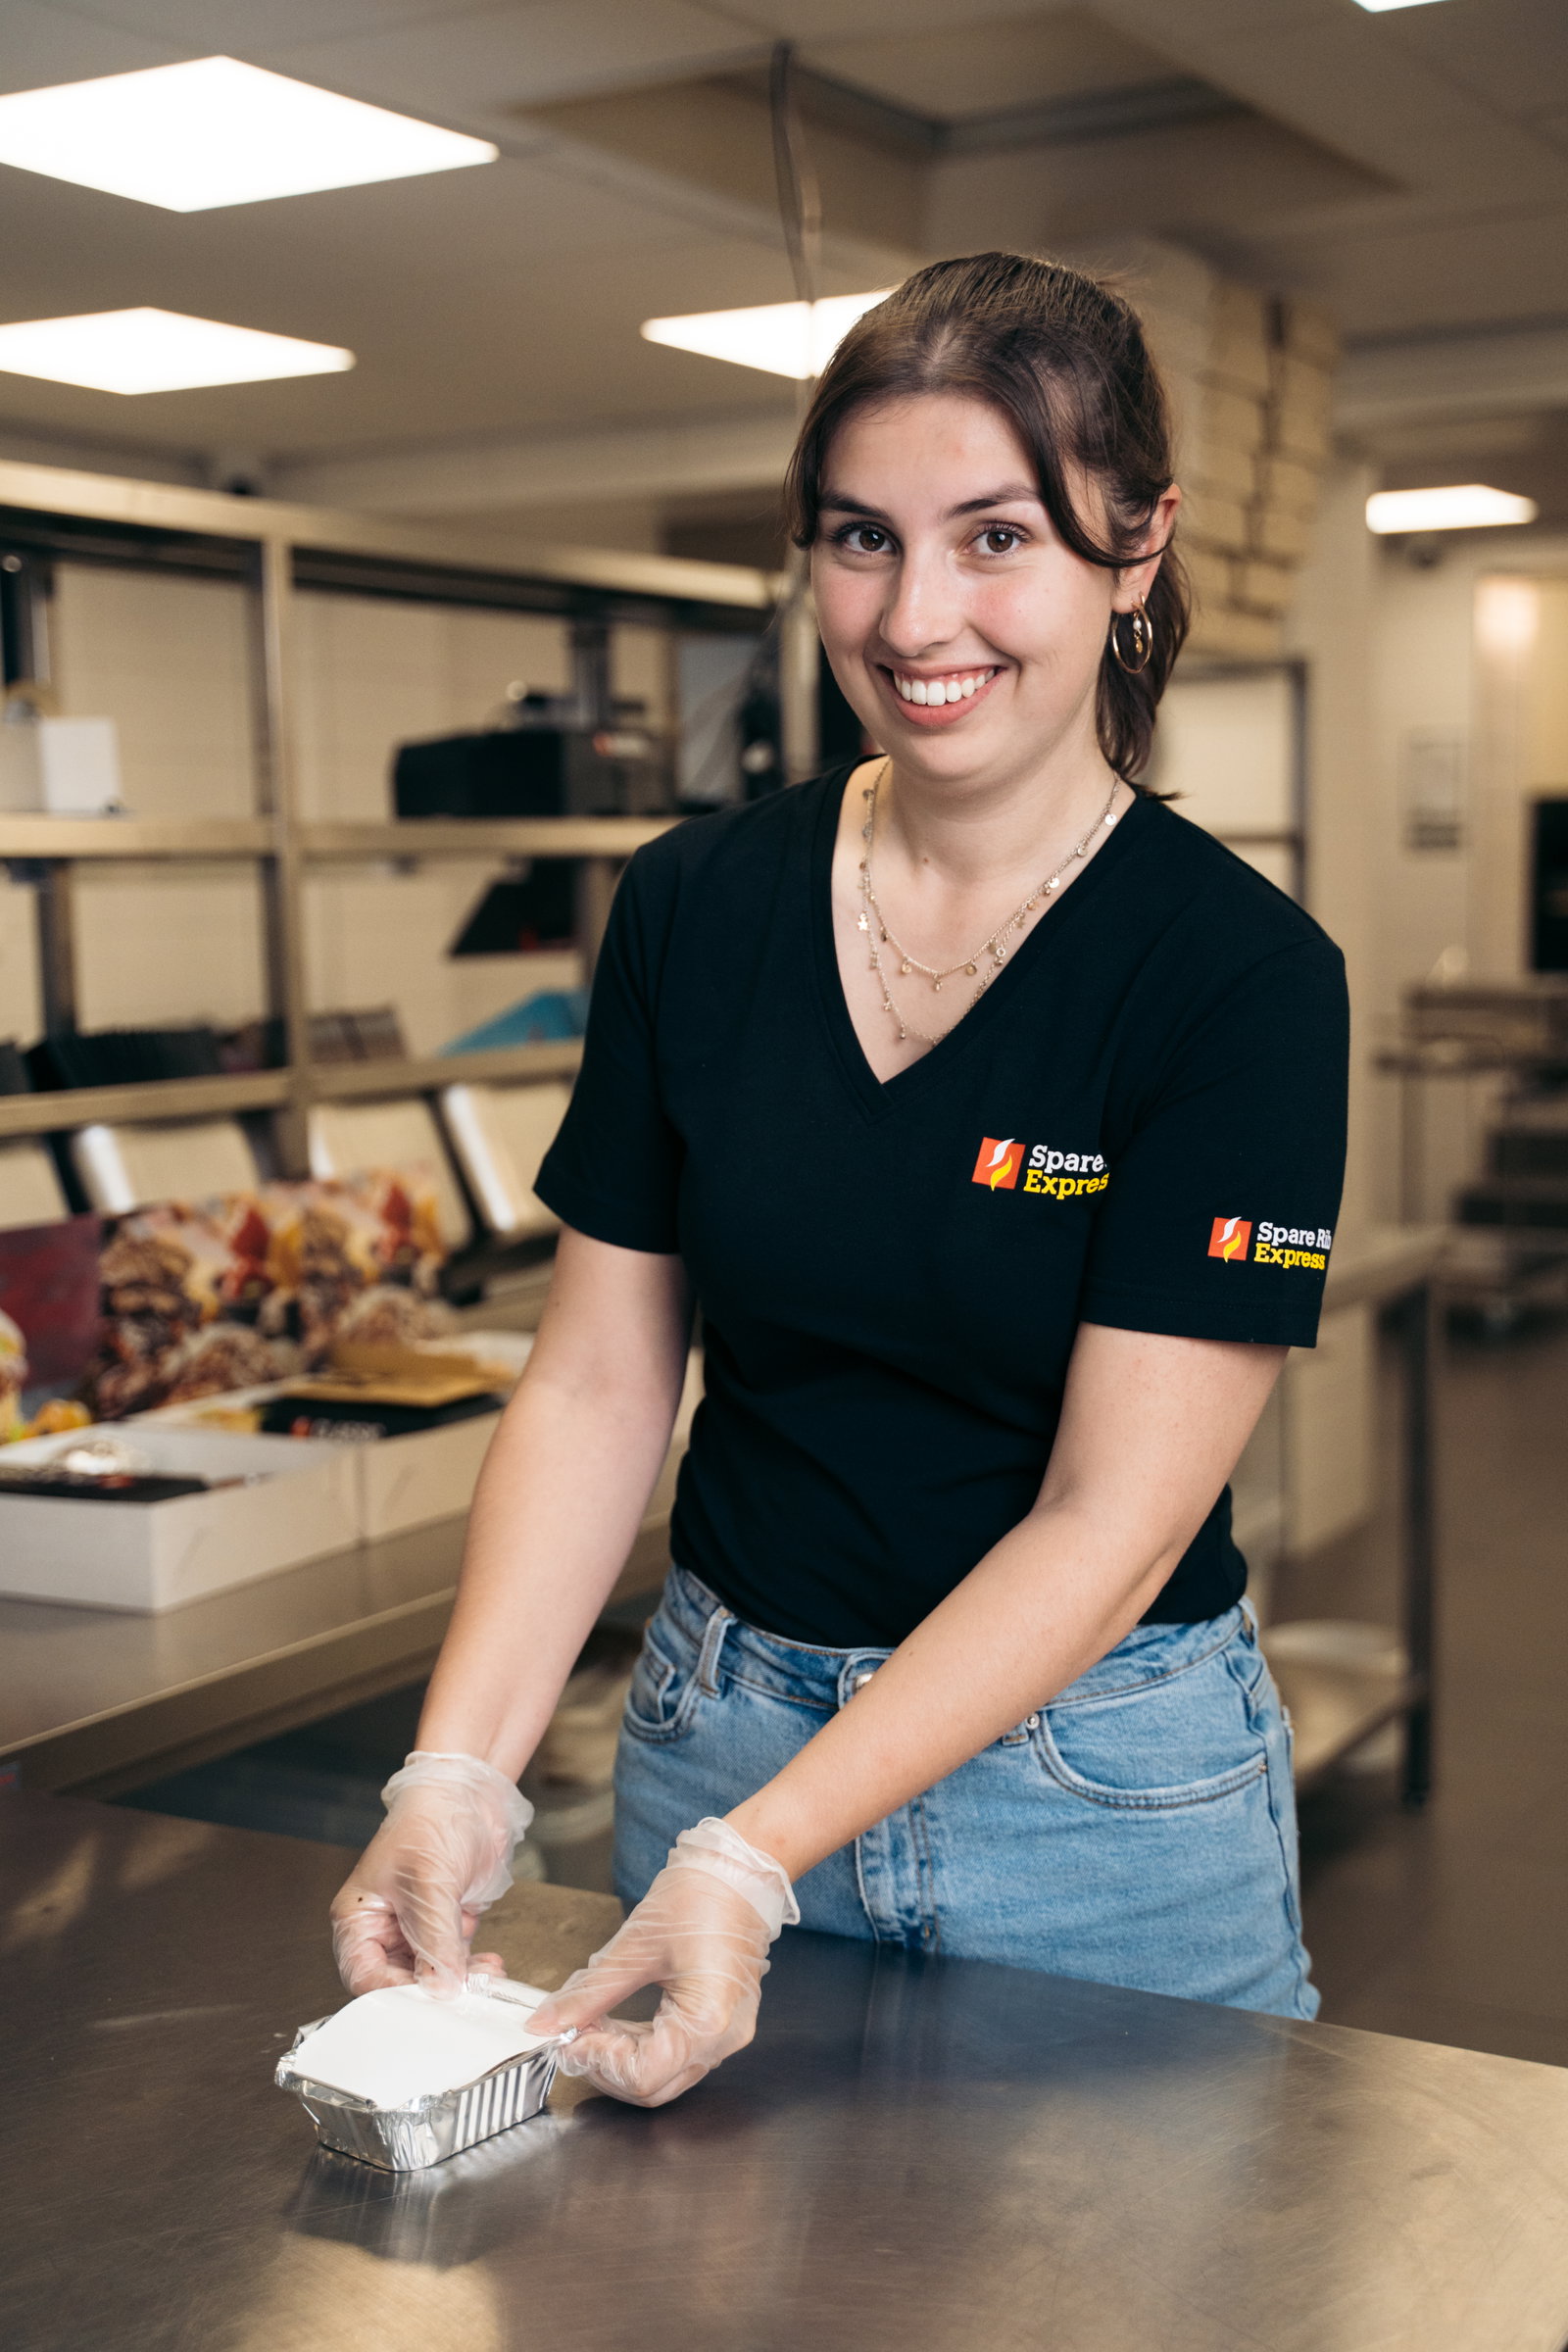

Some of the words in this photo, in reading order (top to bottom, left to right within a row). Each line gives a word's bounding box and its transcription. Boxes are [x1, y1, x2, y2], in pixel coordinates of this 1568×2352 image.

[1028, 1145, 1104, 1174] Spare
[1023, 1169, 1109, 1200] Expres
[1256, 1221, 1315, 1247] Spare
[1253, 1242, 1326, 1270] Express
